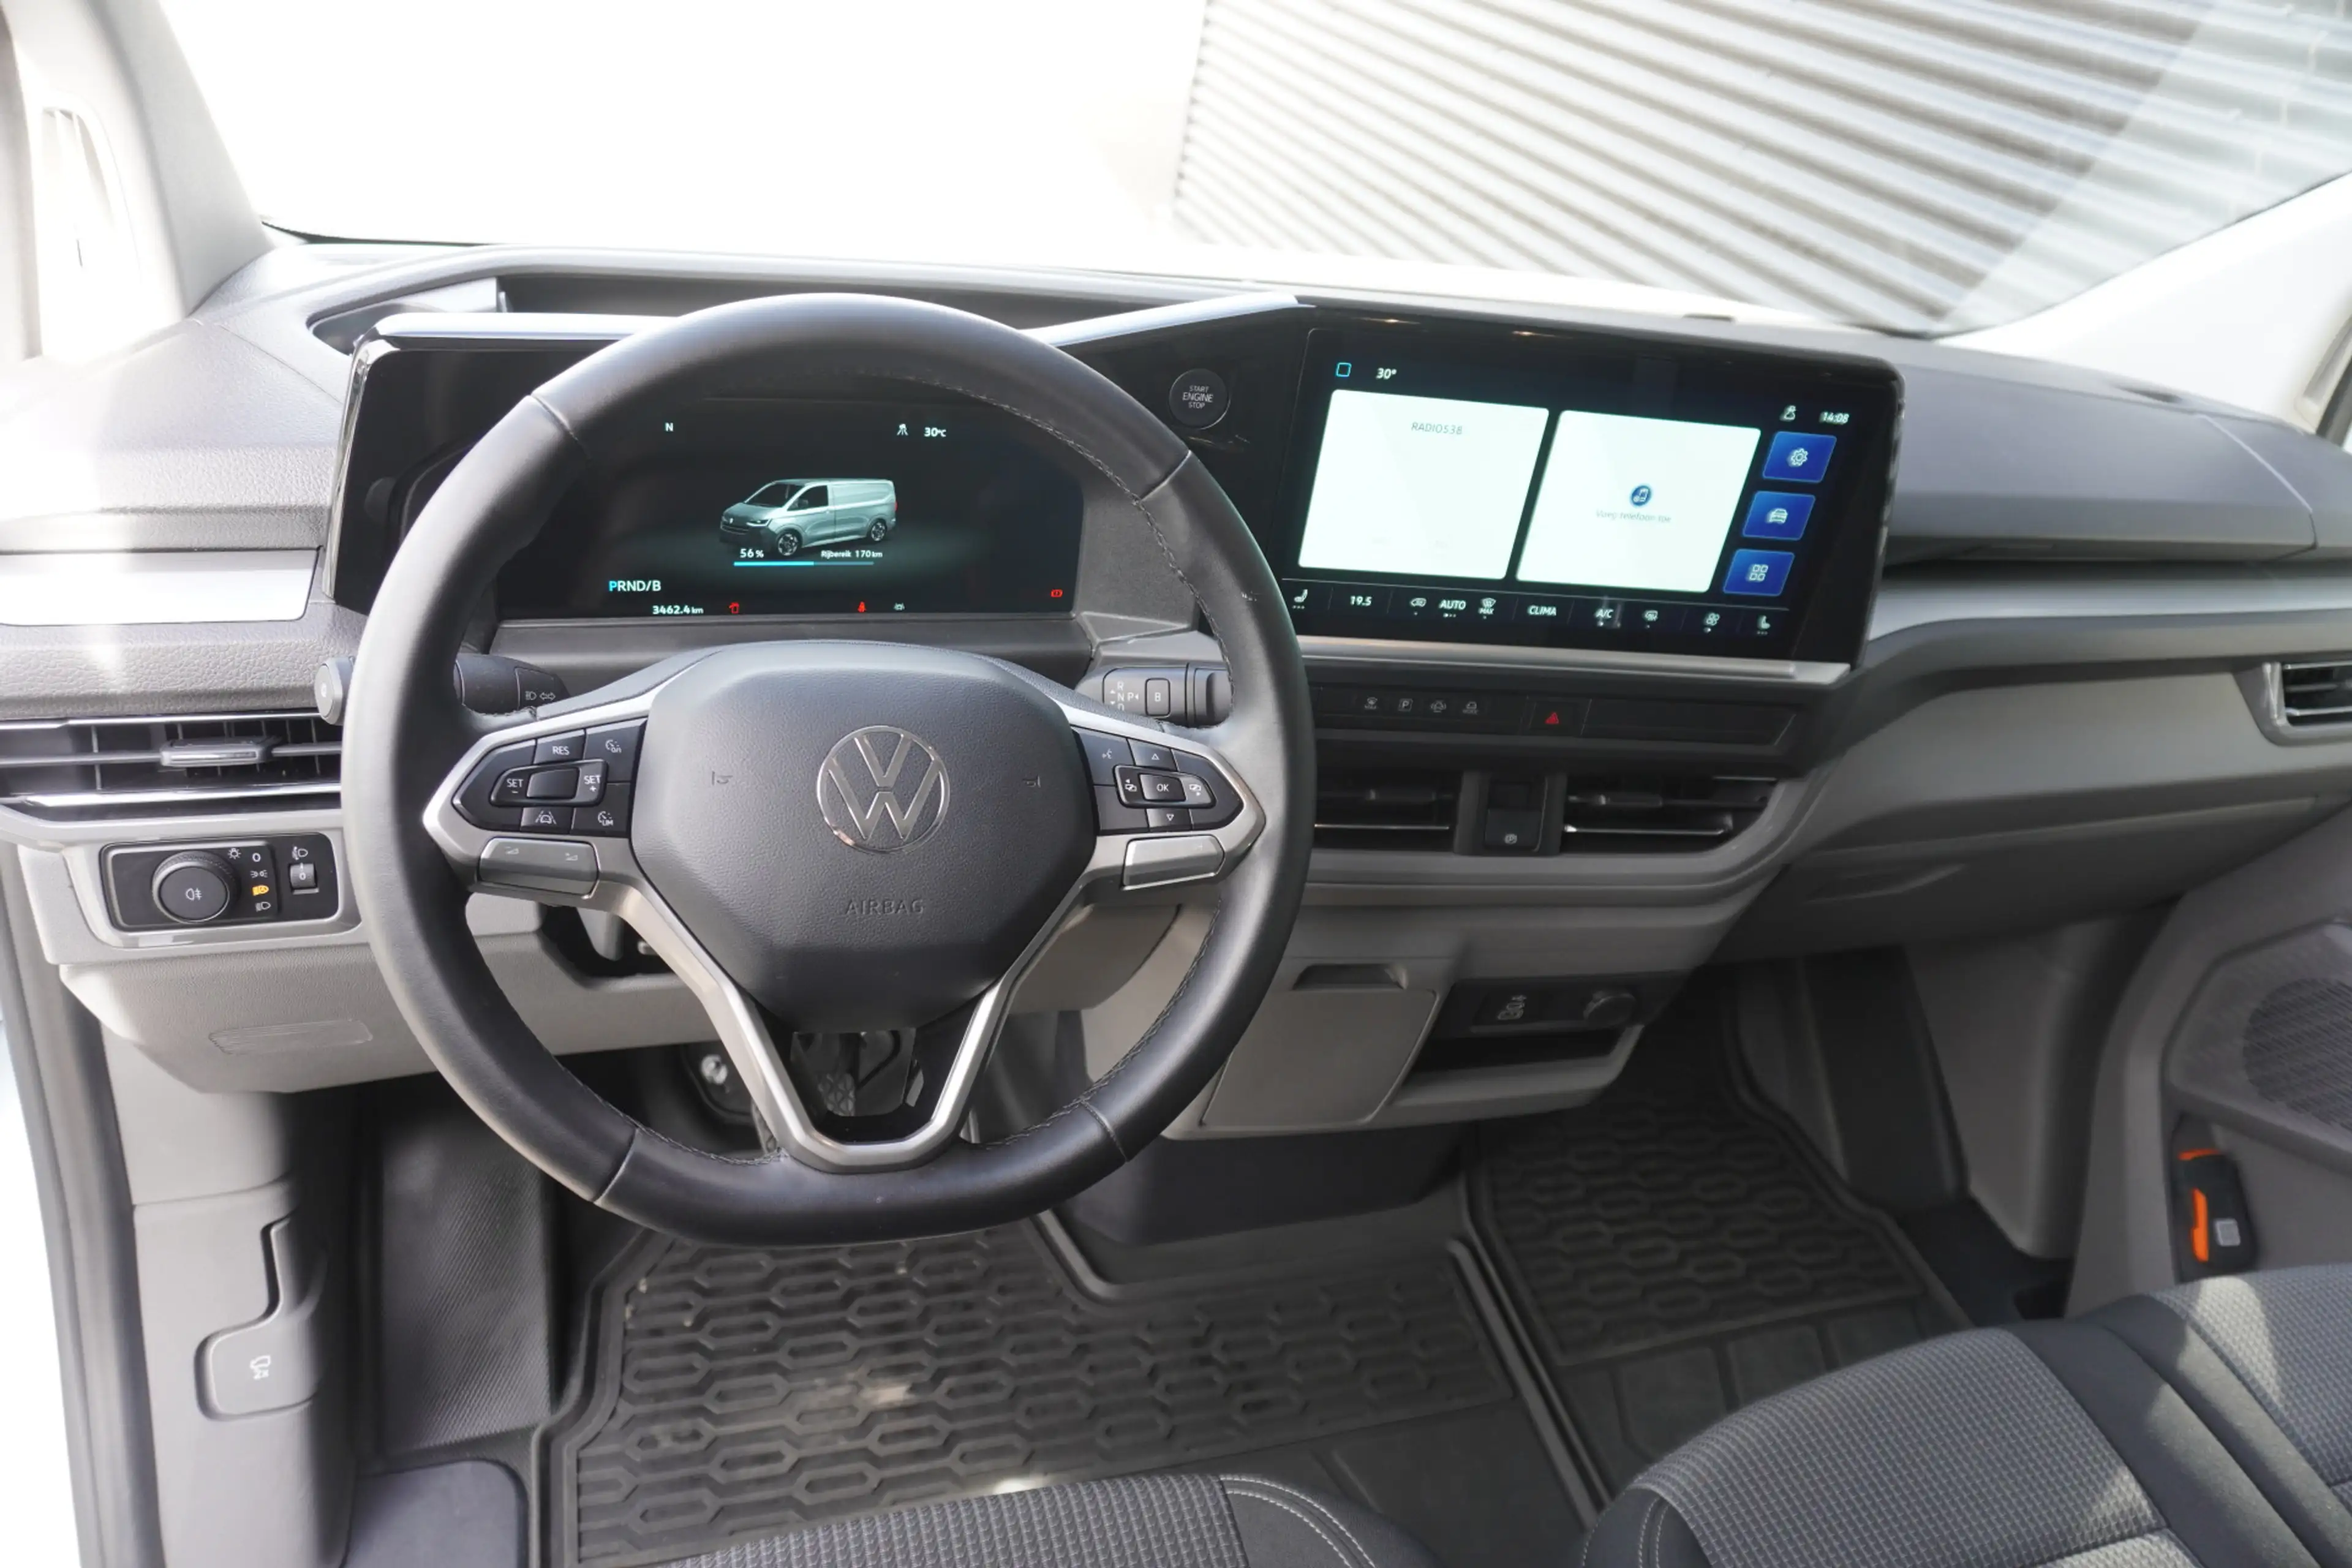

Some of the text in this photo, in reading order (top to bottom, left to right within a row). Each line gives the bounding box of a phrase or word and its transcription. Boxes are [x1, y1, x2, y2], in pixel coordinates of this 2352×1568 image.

[1182, 392, 1213, 402] ENGINE
[1820, 411, 1850, 424] 14:08
[665, 422, 673, 432] N
[739, 548, 754, 558] 56
[609, 580, 662, 592] PRND/B
[1350, 596, 1372, 606] 19.5
[1438, 600, 1466, 610] AUTO
[652, 605, 690, 614] 3462.4
[1528, 606, 1557, 616] CLIMA
[1595, 609, 1614, 619] A/C
[1117, 682, 1124, 690] R
[1117, 693, 1125, 701] N
[1155, 693, 1161, 702] B
[552, 745, 570, 756] RES
[507, 778, 524, 788] SET
[584, 775, 601, 785] SET
[1156, 783, 1169, 792] OK
[846, 898, 924, 915] AIRBAG
